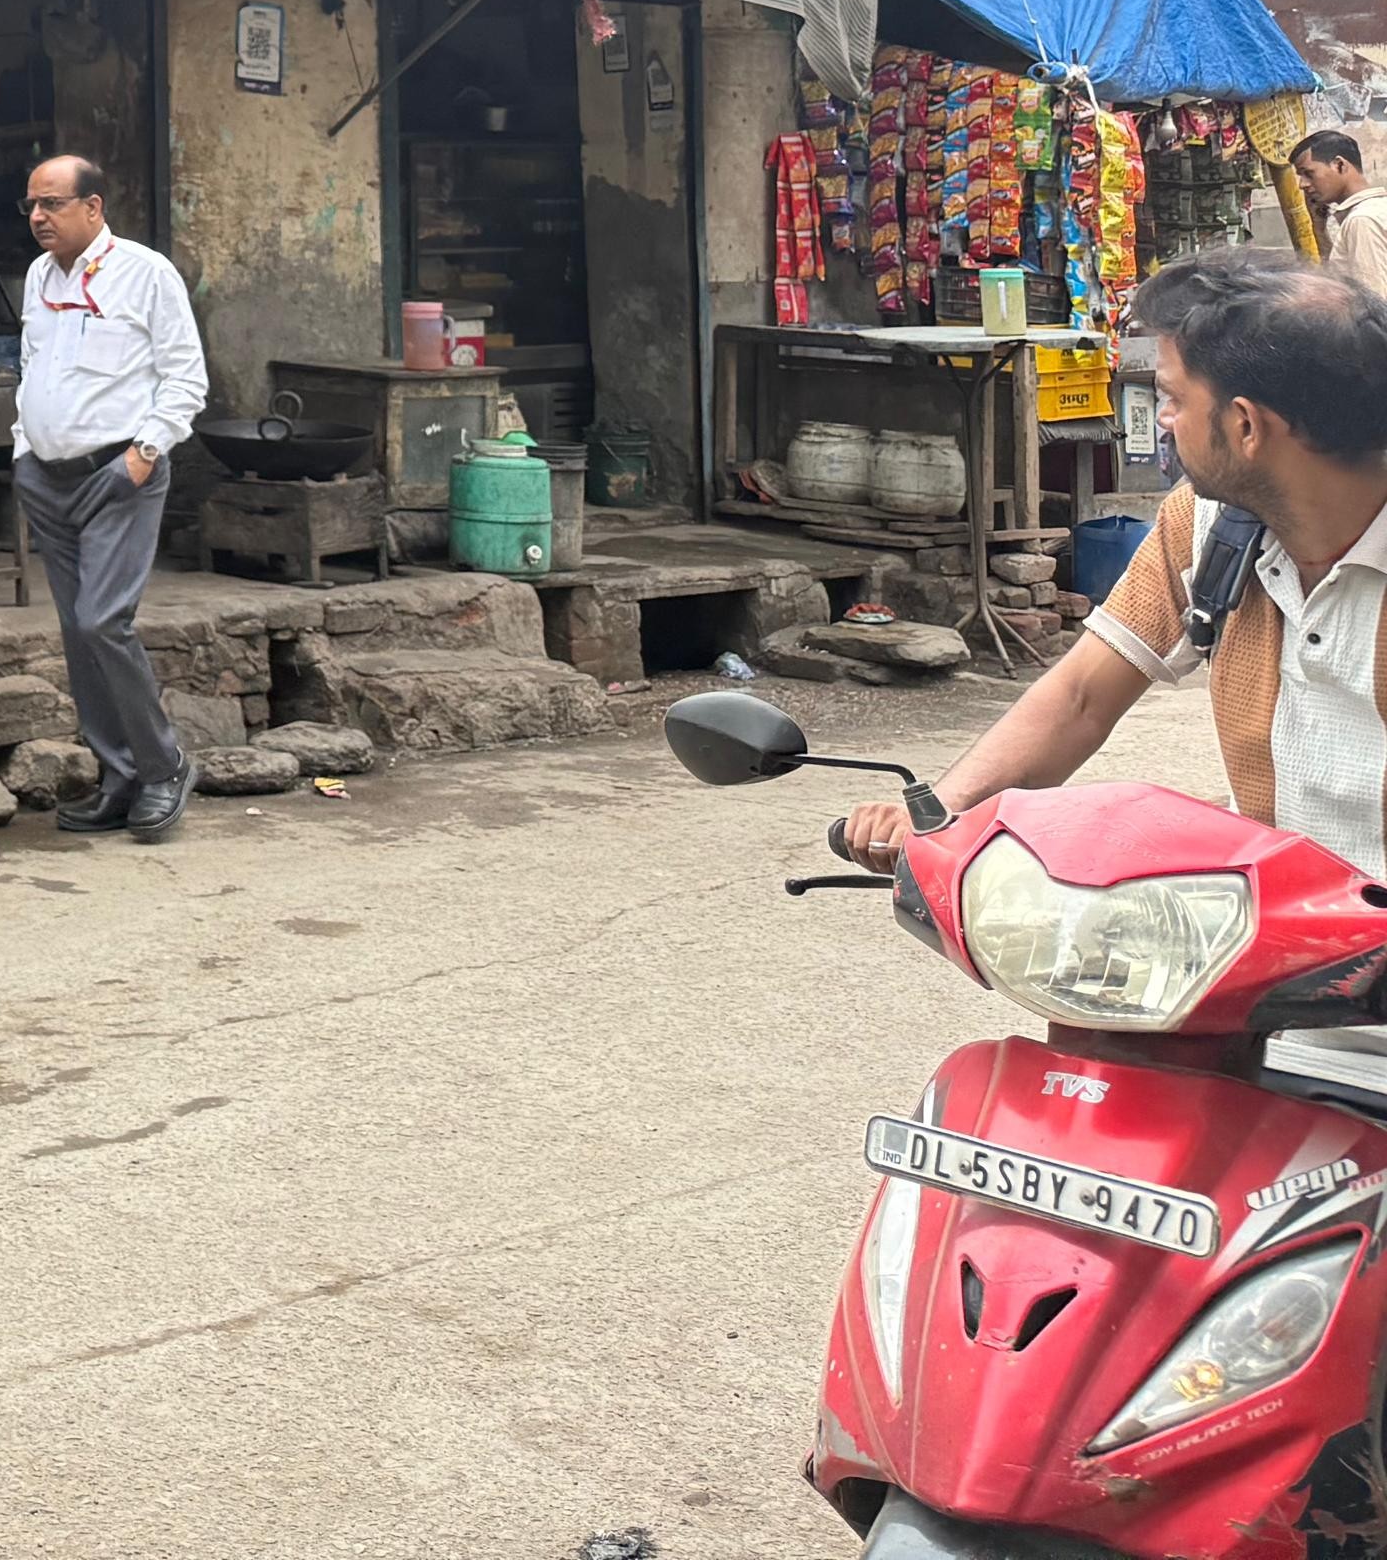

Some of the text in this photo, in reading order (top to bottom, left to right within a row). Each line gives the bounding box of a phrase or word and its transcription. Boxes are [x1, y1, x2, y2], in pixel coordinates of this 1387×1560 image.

[1041, 1071, 1110, 1104] TVS
[882, 1149, 902, 1165] IND
[910, 1133, 951, 1179] DL
[1093, 1184, 1198, 1247] 9470
[1245, 1397, 1285, 1422] TECH
